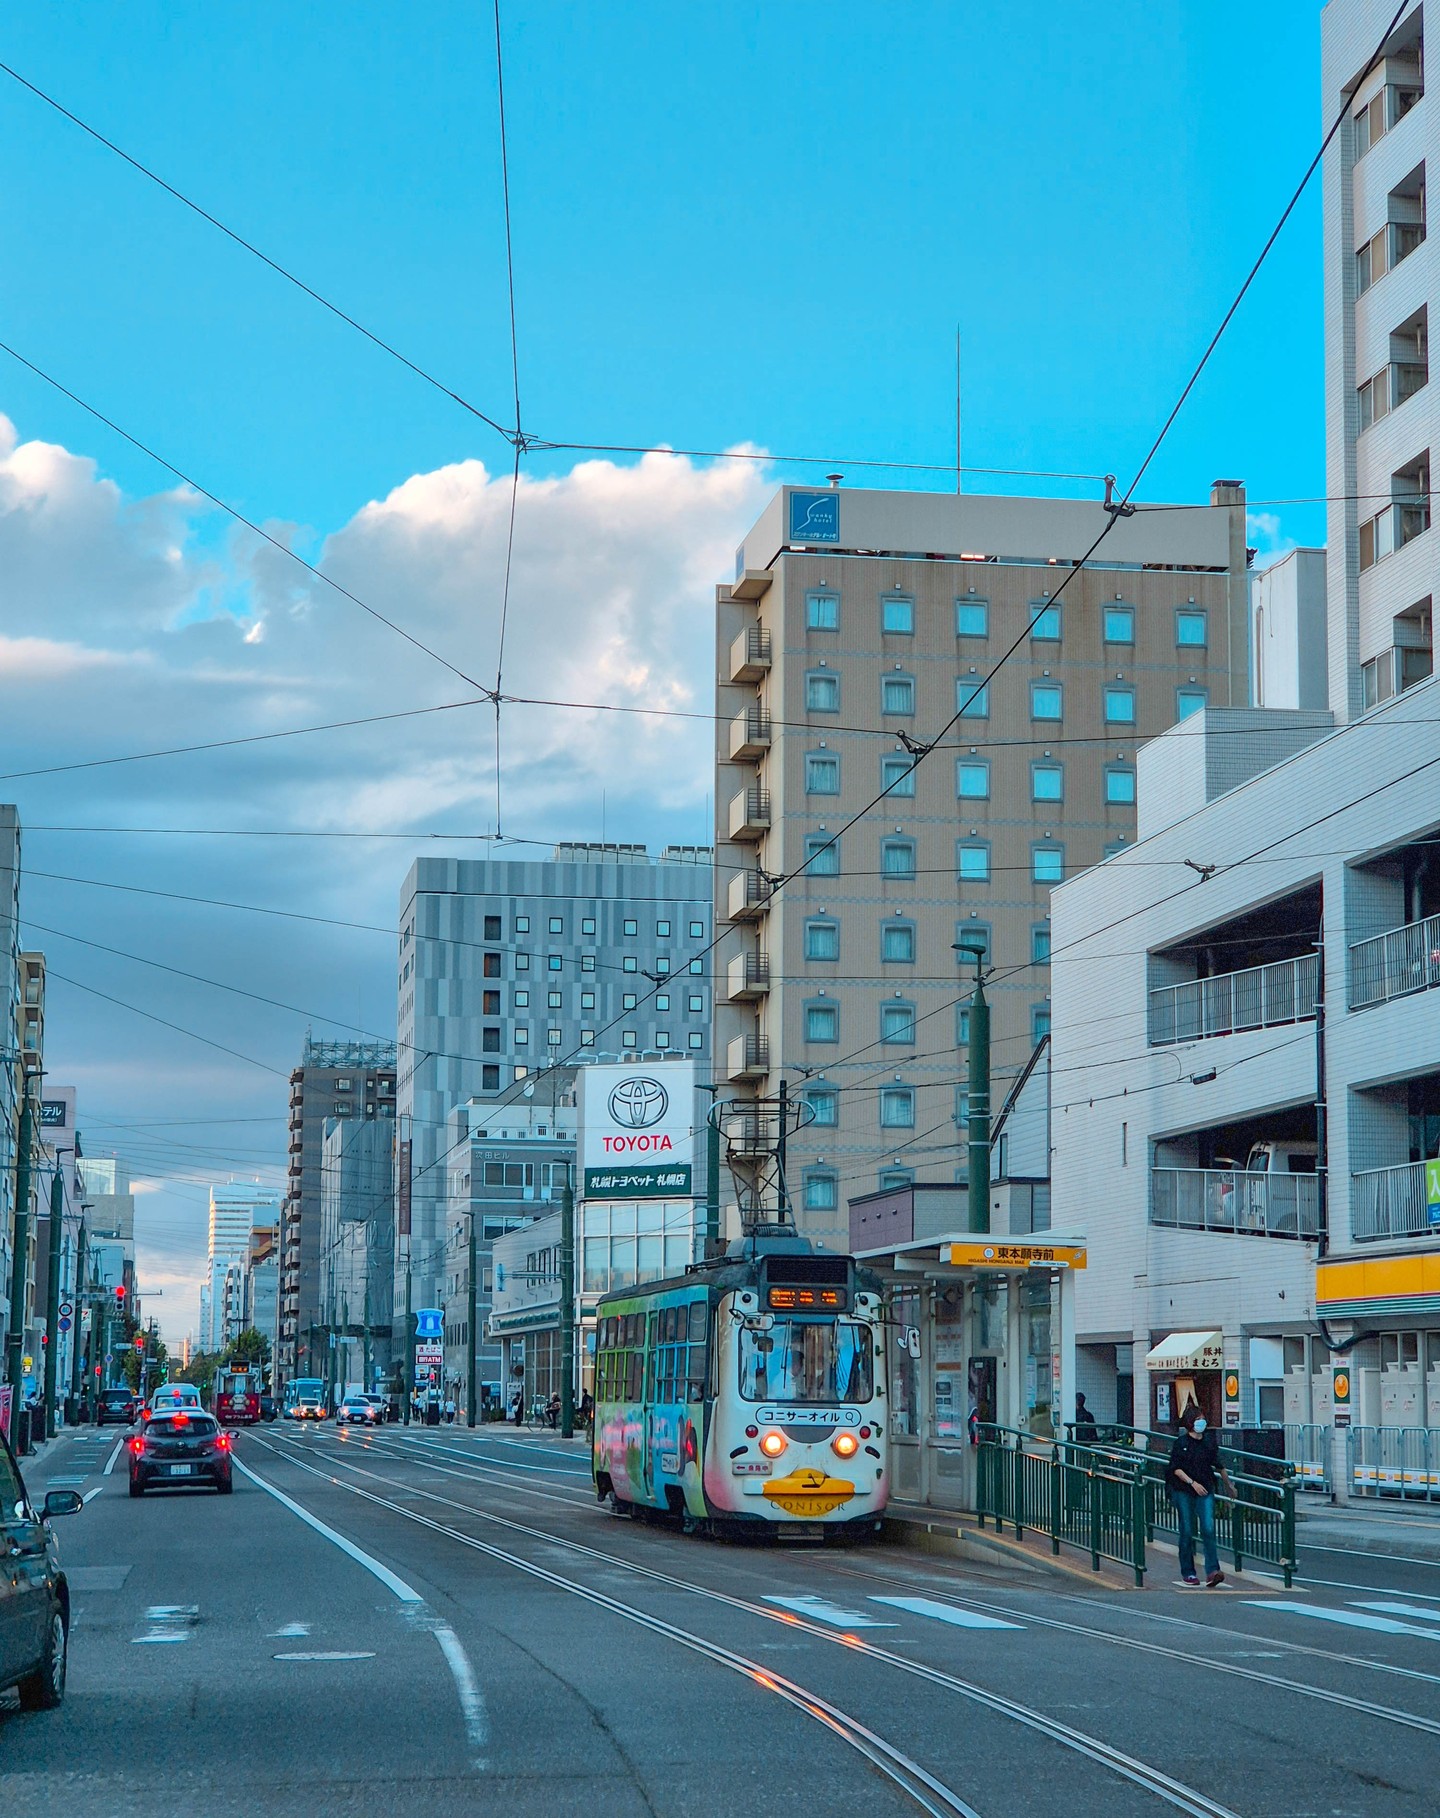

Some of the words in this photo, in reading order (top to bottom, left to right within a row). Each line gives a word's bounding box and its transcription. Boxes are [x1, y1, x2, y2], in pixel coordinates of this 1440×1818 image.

[40, 1106, 61, 1116] テル
[602, 1135, 672, 1152] TOYOTA
[590, 1174, 654, 1188] 札幌トヨペット
[656, 1173, 687, 1186] 札幌店
[998, 1247, 1054, 1261] 東本願寺前
[1203, 1347, 1223, 1356] 豚丼
[1192, 1358, 1219, 1368] まむろ
[764, 1411, 840, 1422] コニサーオイル
